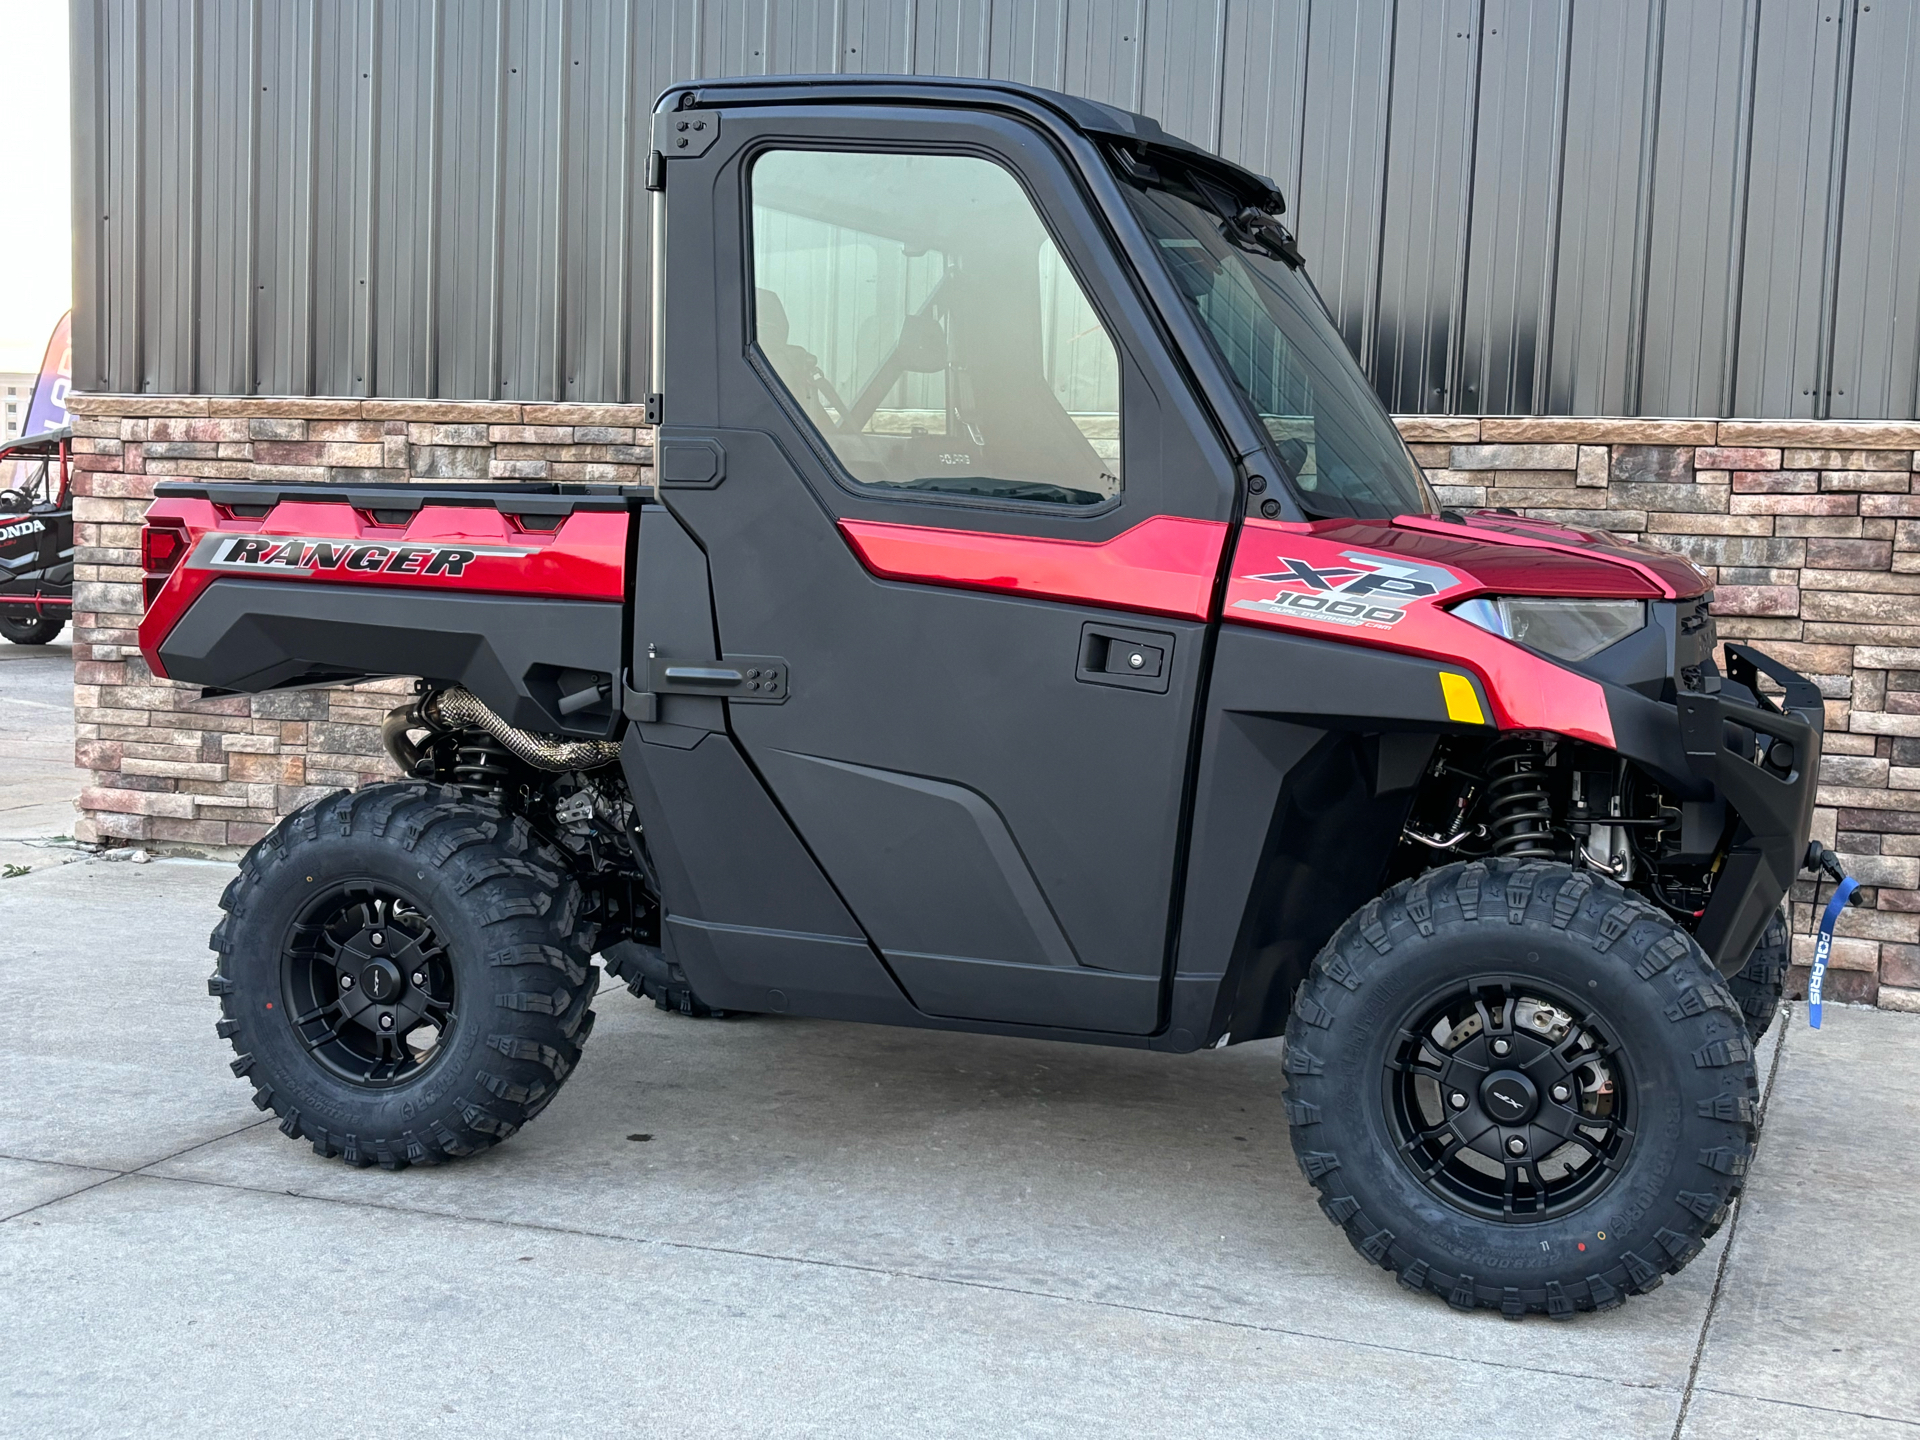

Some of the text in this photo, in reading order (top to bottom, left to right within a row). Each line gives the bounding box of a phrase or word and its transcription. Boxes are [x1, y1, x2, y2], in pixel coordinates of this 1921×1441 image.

[222, 537, 475, 577] RANGER
[1240, 556, 1439, 597] XP
[1269, 606, 1298, 615] DUAL
[1364, 622, 1393, 631] CAM
[1276, 590, 1407, 624] 1000
[1810, 931, 1830, 1005] POLARIS
